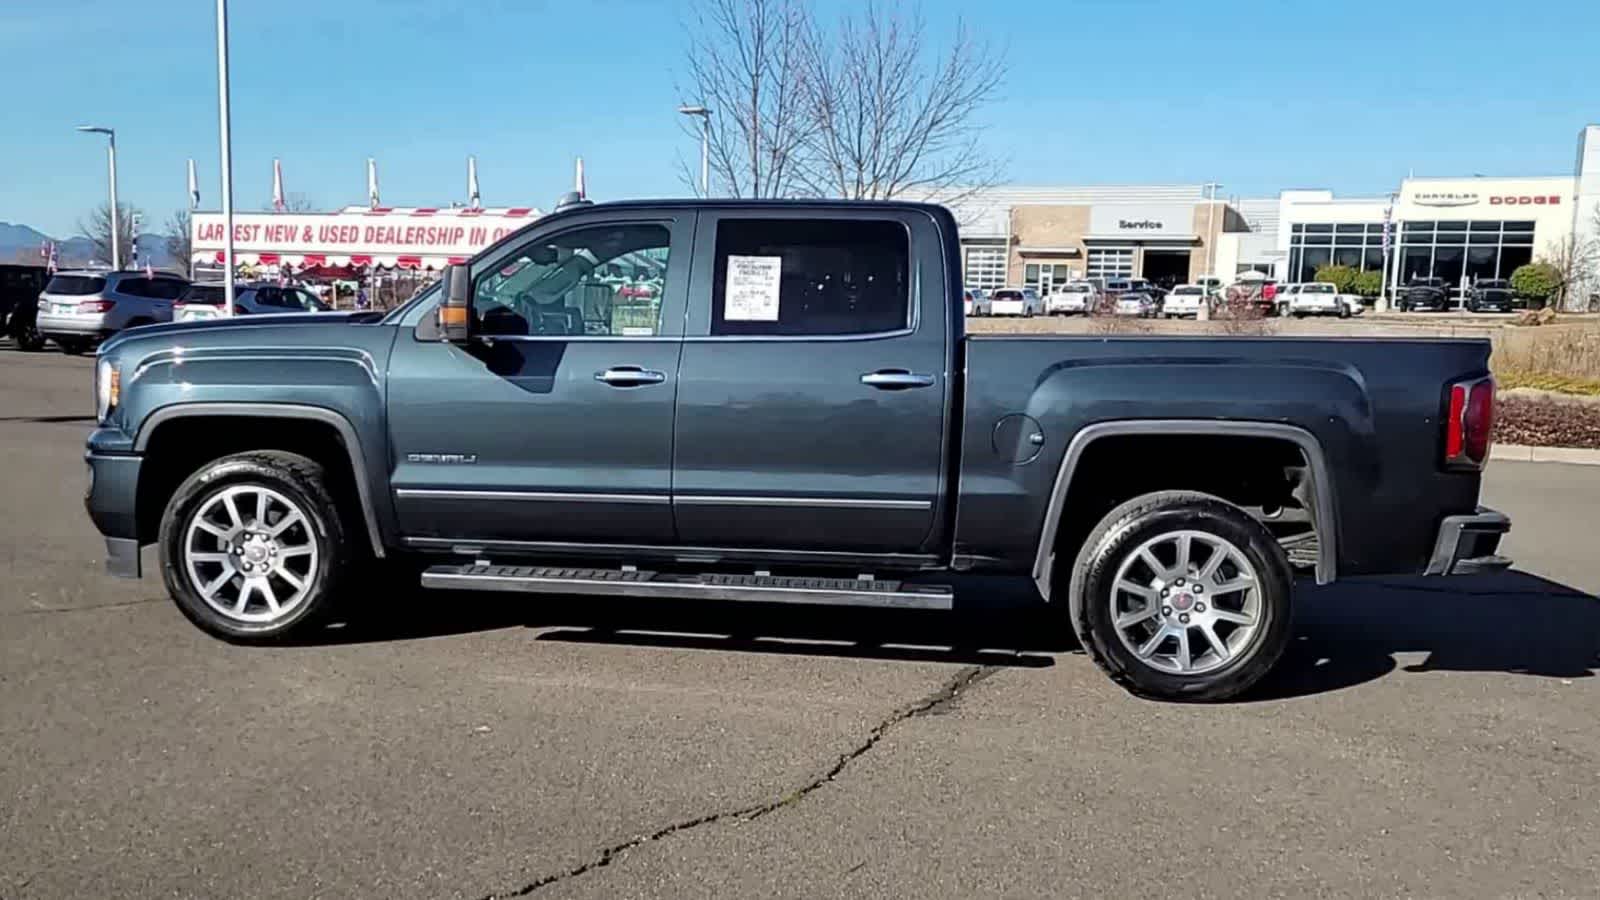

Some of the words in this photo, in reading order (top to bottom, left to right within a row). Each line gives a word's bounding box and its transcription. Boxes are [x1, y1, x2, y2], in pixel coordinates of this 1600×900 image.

[1490, 195, 1561, 205] DODGE
[1119, 219, 1163, 229] Service
[198, 223, 260, 241] LAREST
[264, 224, 298, 242] NEW
[302, 225, 313, 243] &
[319, 225, 359, 244] USED
[364, 225, 464, 245] DEALERSHIP
[469, 227, 487, 246] IN
